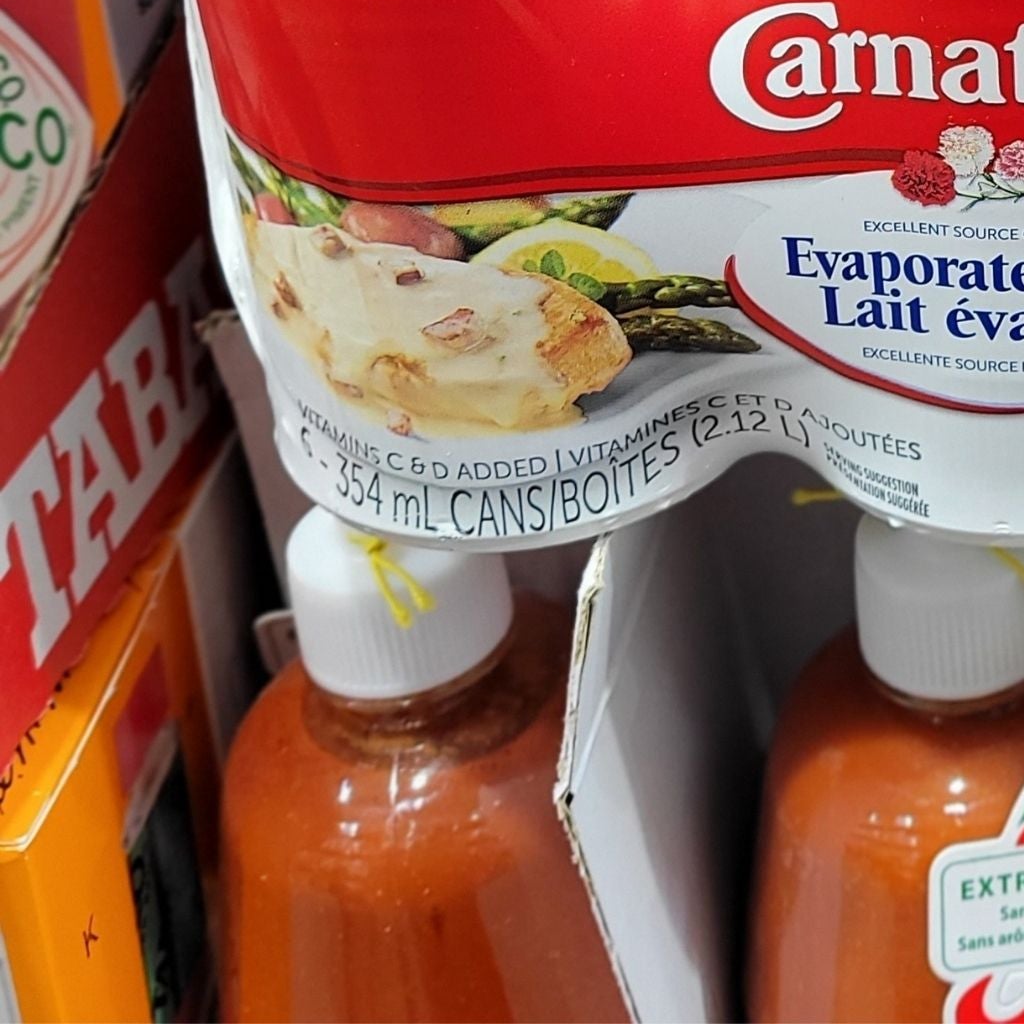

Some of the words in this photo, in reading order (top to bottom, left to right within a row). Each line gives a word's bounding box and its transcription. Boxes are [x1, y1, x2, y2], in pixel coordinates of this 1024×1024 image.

[863, 220, 949, 238] EXCELLENT
[953, 225, 1020, 241] SOURCE
[819, 284, 930, 334] Lait
[862, 346, 952, 369] EXCELLENTE
[955, 356, 1020, 373] SOURCE
[298, 399, 381, 466] VITAMINS
[386, 452, 405, 472] C
[411, 456, 427, 475] &
[432, 461, 449, 480] D
[456, 456, 547, 480] ADDED
[569, 400, 701, 466] VITAMINES
[707, 395, 728, 408] C
[735, 394, 765, 406] ET
[774, 398, 793, 412] D
[801, 407, 922, 461] AJOUTÉES
[335, 451, 384, 516] 354
[392, 484, 438, 532] mL
[450, 430, 681, 537] CANS/BOÎTES
[691, 409, 772, 448] (2.12
[780, 414, 811, 448] L)
[863, 467, 919, 497] SUGGESTION
[886, 492, 930, 518] SUGGÉRÉE
[957, 935, 995, 953] Sans
